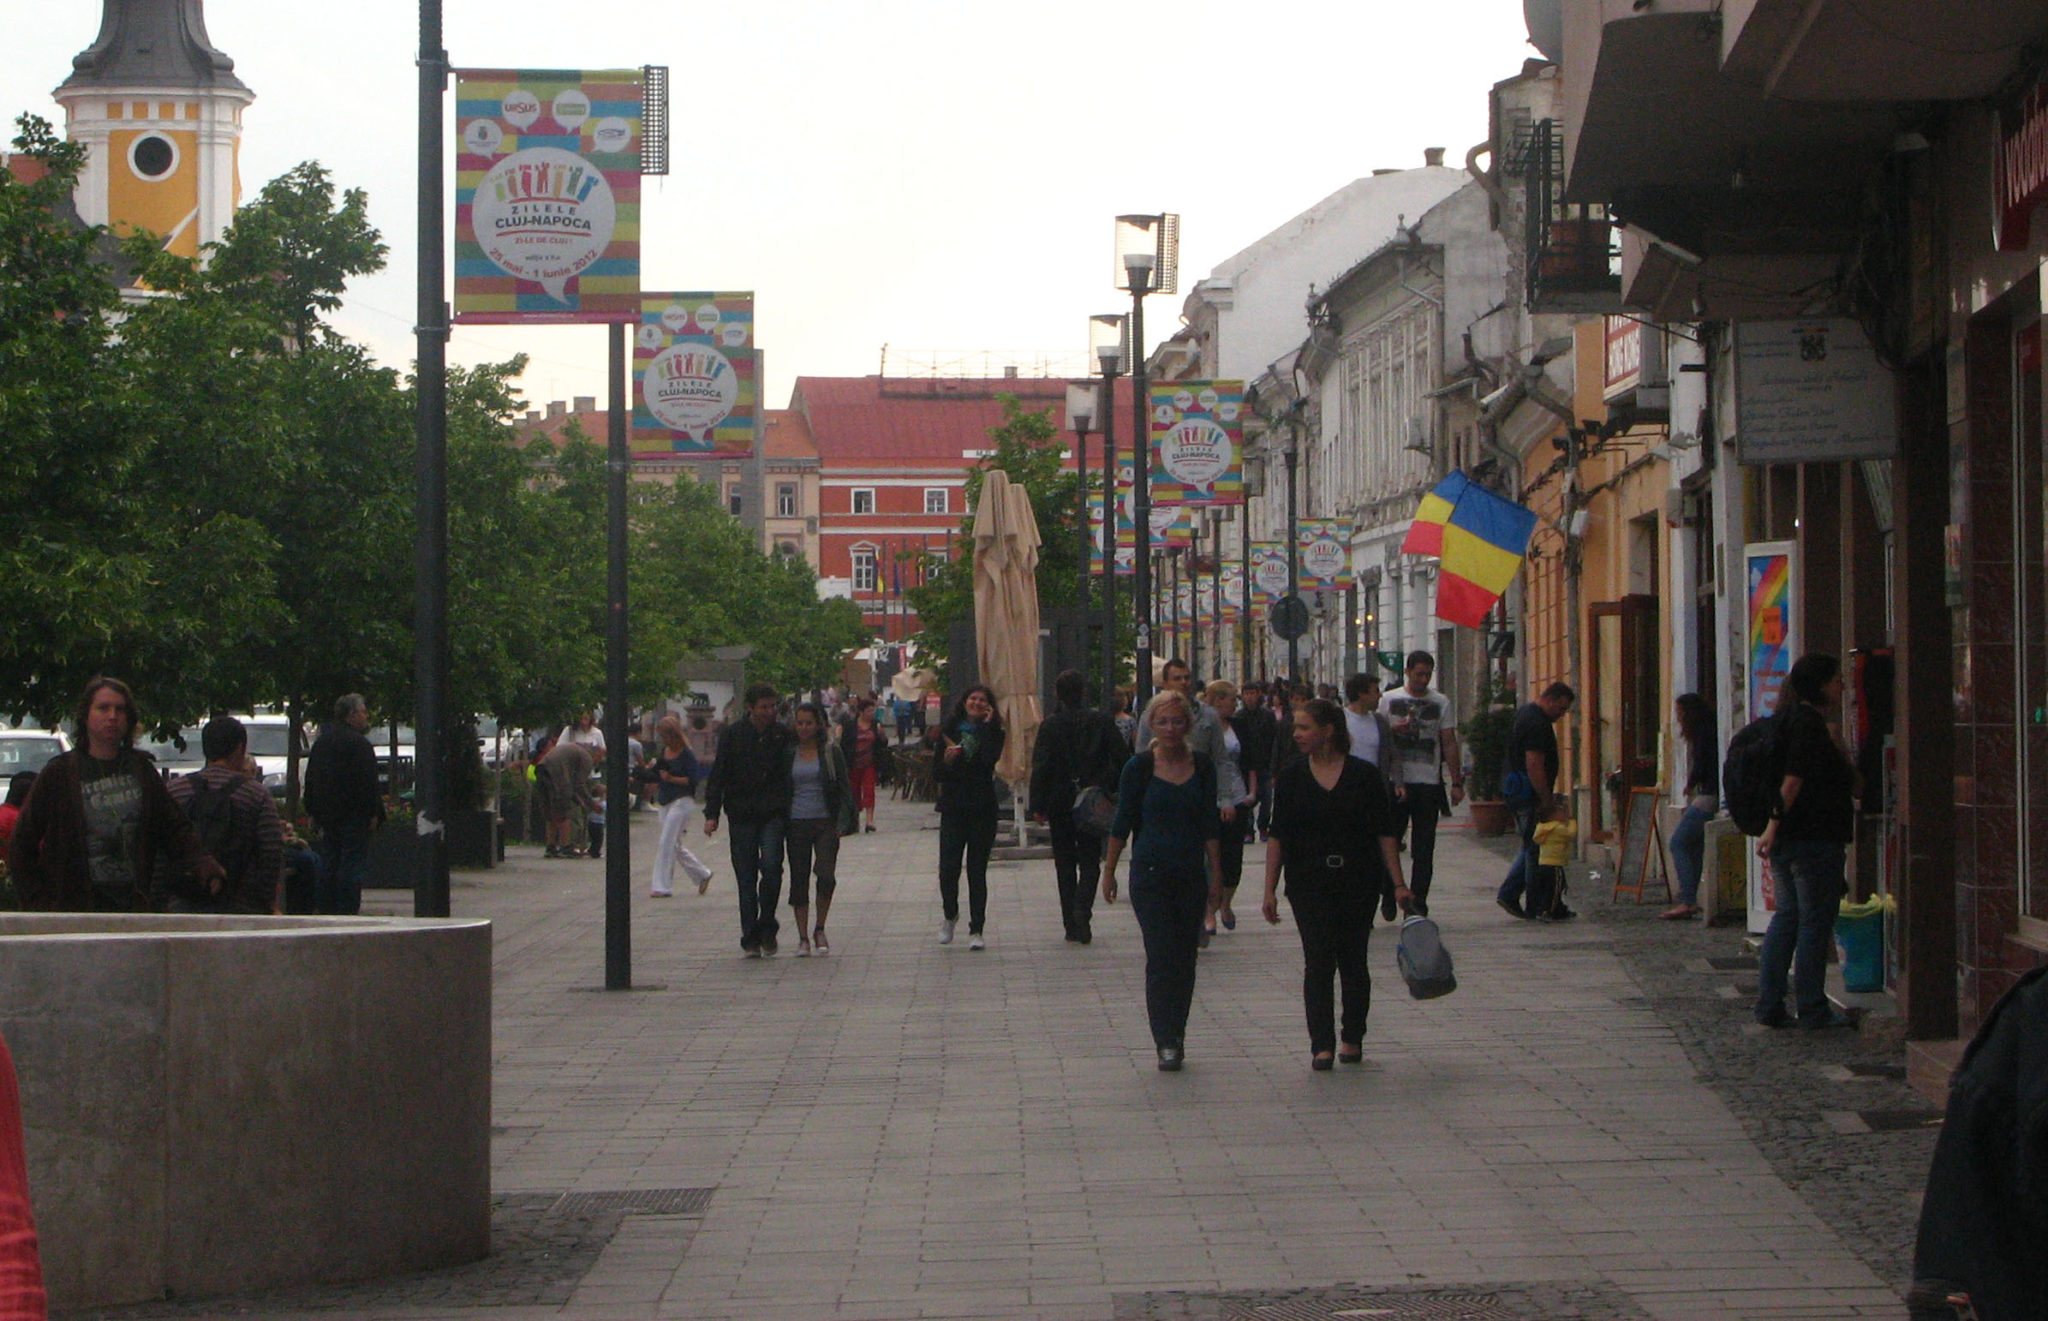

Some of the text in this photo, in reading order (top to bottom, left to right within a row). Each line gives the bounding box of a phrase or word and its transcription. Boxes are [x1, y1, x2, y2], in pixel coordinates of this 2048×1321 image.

[511, 204, 577, 215] ZILELE
[495, 215, 592, 230] CLUJ-NAPOCA
[488, 247, 504, 262] 25
[502, 259, 524, 275] mai
[533, 268, 539, 277] 1
[543, 267, 572, 278] iunie
[572, 249, 598, 271] 2012
[658, 388, 722, 398] CLUJ-NAPOCA
